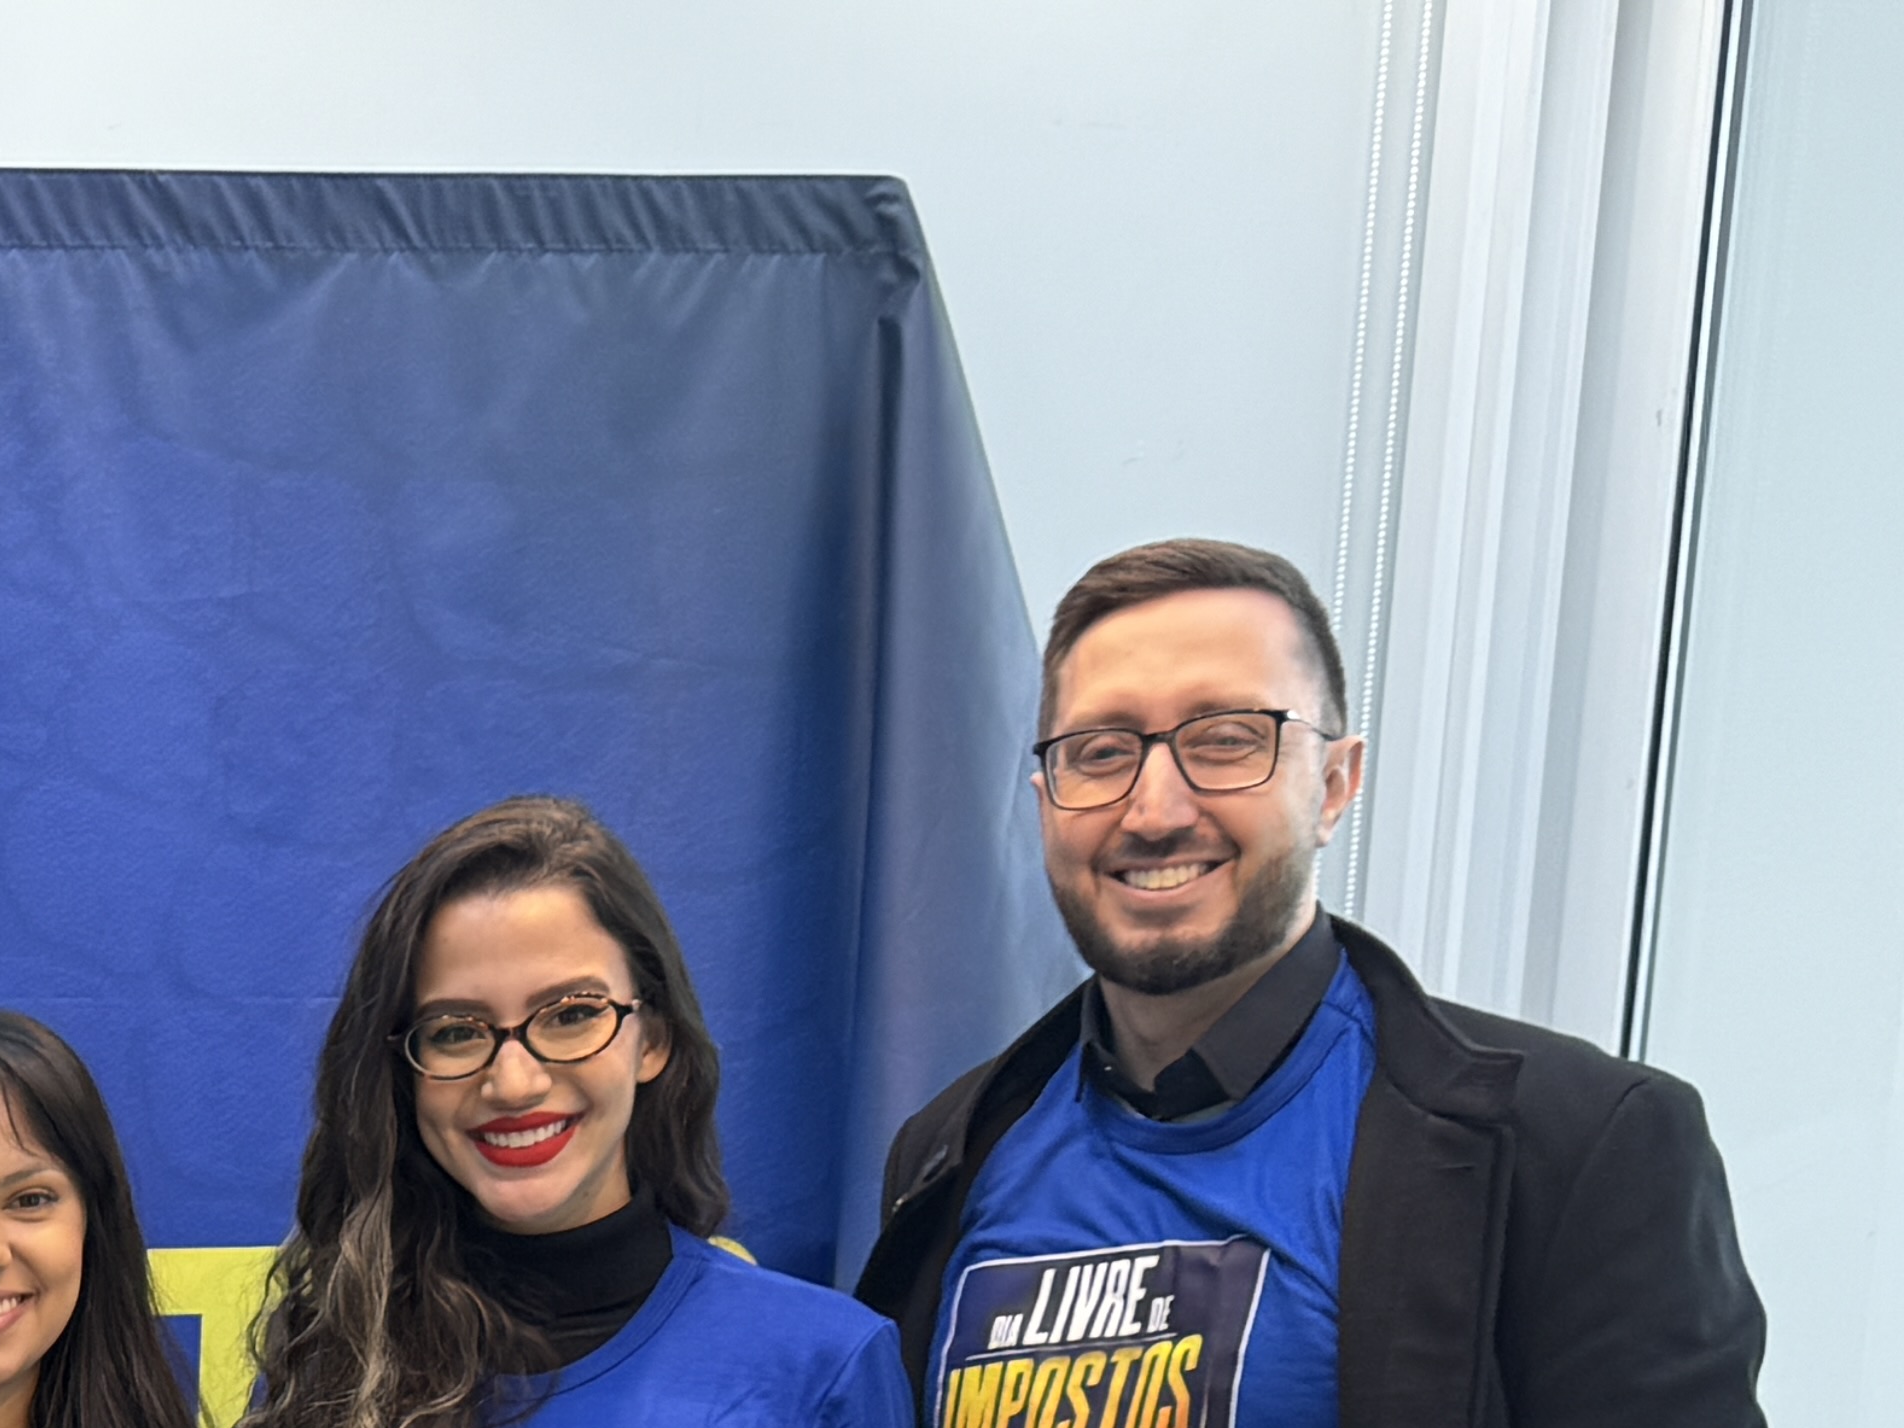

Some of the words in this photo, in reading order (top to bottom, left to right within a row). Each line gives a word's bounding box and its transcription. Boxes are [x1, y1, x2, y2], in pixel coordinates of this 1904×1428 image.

[988, 1313, 1023, 1349] DIA
[1022, 1256, 1159, 1345] LIVRE
[1148, 1296, 1174, 1330] DE
